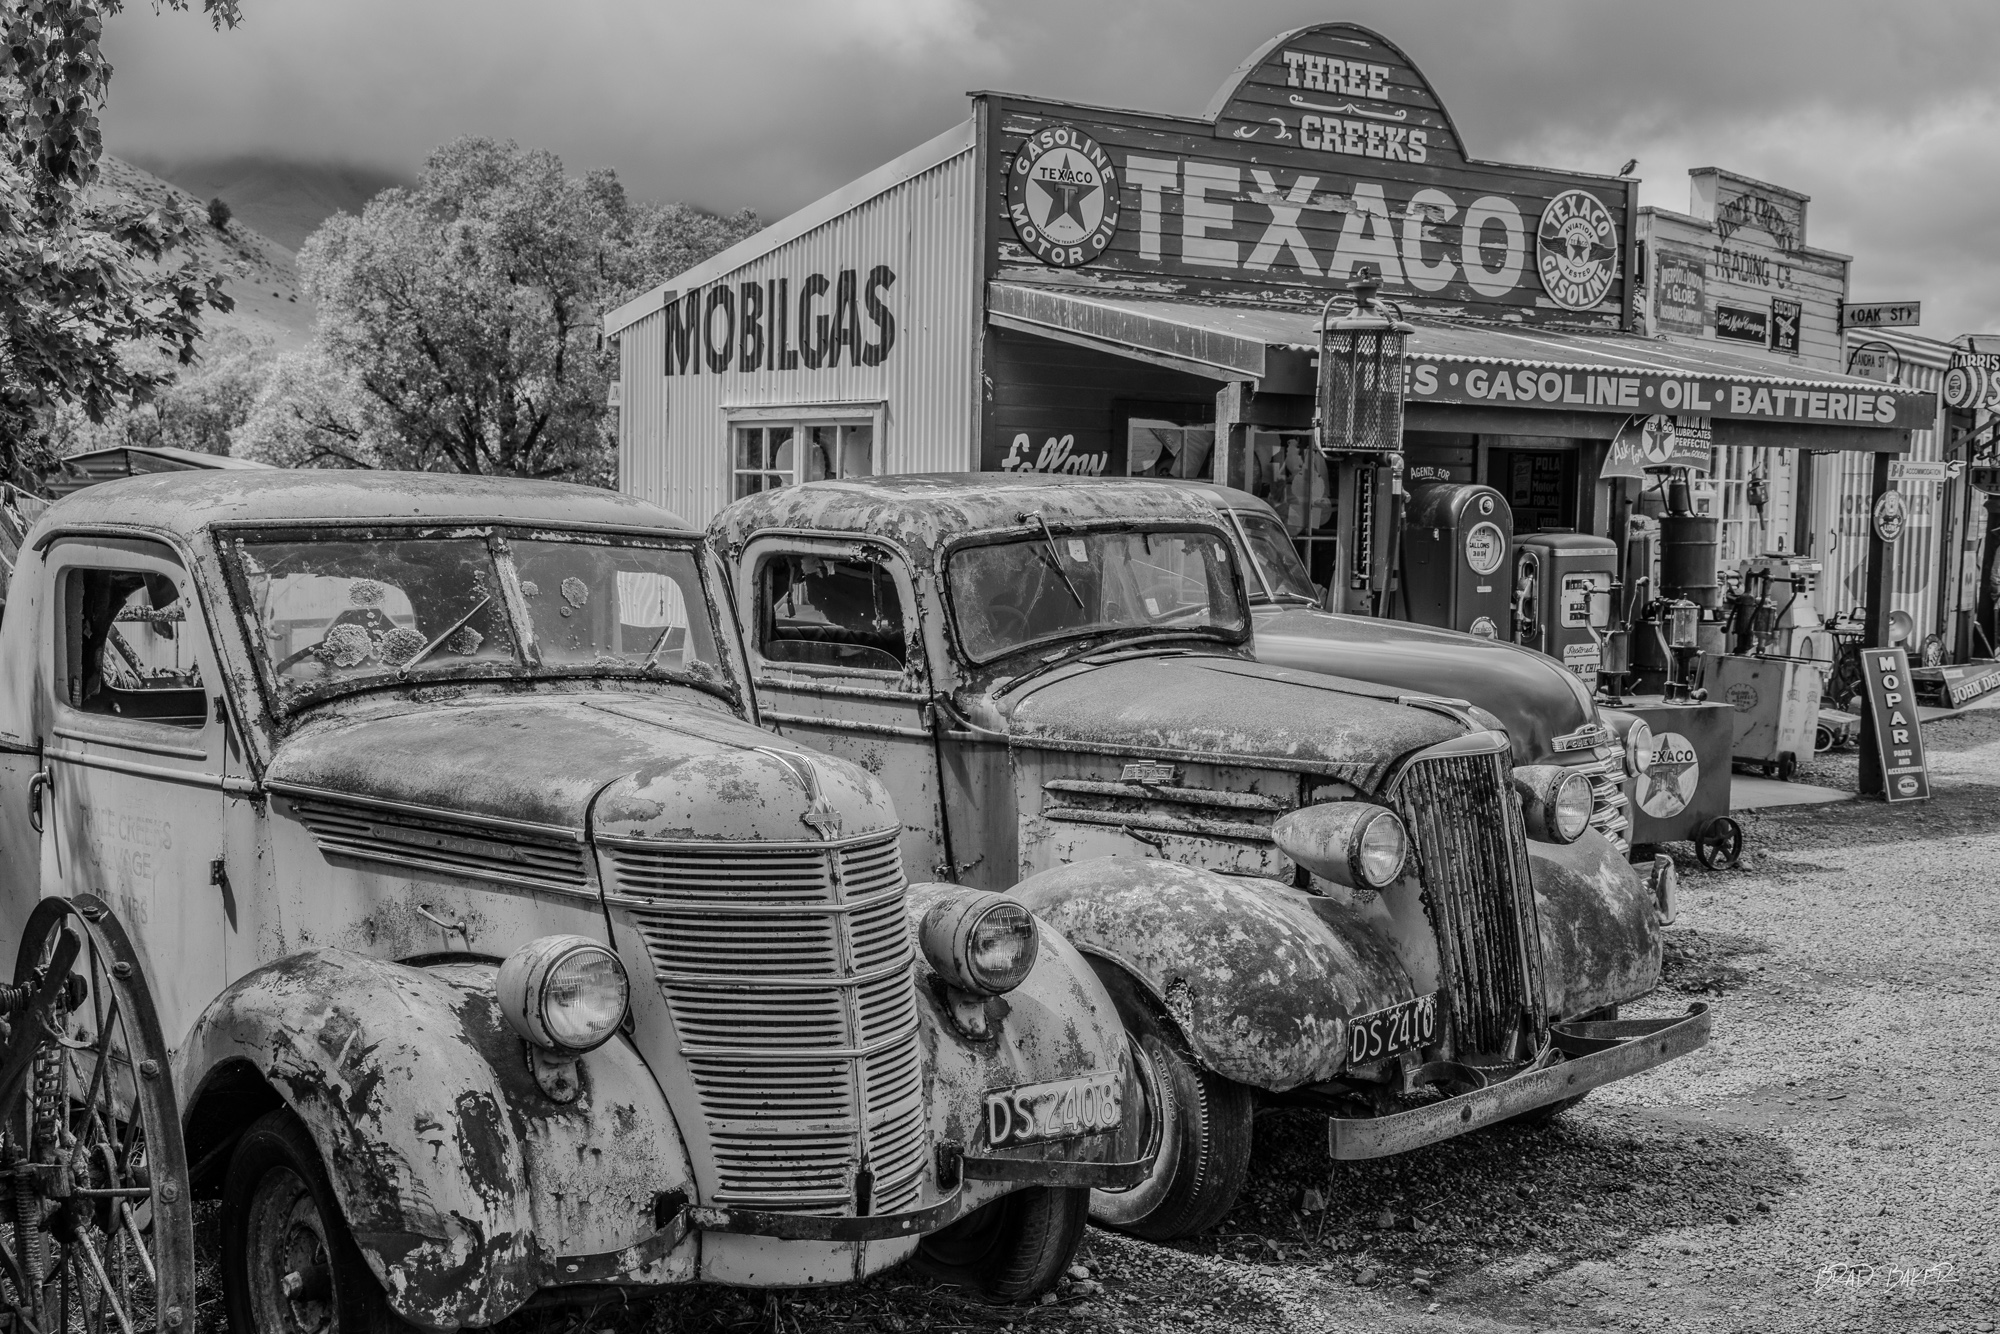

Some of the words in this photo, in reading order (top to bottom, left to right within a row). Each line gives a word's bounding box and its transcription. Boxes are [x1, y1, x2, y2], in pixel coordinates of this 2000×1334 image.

[1283, 50, 1390, 100] THREE
[1300, 115, 1428, 164] CREEKS
[1016, 129, 1115, 184] GASOLINE
[1040, 167, 1093, 184] TEXACO
[1126, 155, 1526, 297] TEXACO
[1545, 195, 1610, 237] TEXACO
[1010, 203, 1084, 264] MOTOR
[1092, 212, 1118, 249] OIL
[1565, 222, 1594, 239] AVIATION
[1564, 265, 1591, 278] TESTED
[1714, 245, 1770, 286] TRADING
[1542, 255, 1611, 305] GASOLINE
[1672, 284, 1696, 305] GLOBE
[664, 264, 896, 376] MOBILGAS
[1773, 301, 1800, 318] SOCONY
[1857, 308, 1882, 322] OAK
[1890, 307, 1905, 321] ST
[1950, 354, 2000, 371] HARRIS
[1465, 369, 1640, 407] GASOLINE
[1660, 378, 1712, 411] OIL
[1730, 385, 1896, 424] BATTERIES
[1944, 366, 2000, 408] OILS
[1647, 421, 1674, 433] TEXCO
[1675, 426, 1709, 438] LUBRICATES
[1676, 414, 1698, 428] MOTOR
[1699, 415, 1710, 429] OIL
[1614, 439, 1629, 466] Ask
[1674, 435, 1709, 447] PERFECTLY
[1001, 433, 1108, 477] fllow
[1410, 466, 1434, 480] AGENTS
[1437, 468, 1451, 481] FOR
[1906, 467, 1941, 476] ACCOMMODATION
[1878, 656, 1909, 744] MOPAR
[1952, 680, 1982, 704] JOHN
[1650, 749, 1694, 763] EXACO
[1893, 749, 1913, 757] PARTS
[1887, 765, 1924, 775] ACCESSORIES
[1352, 1020, 1382, 1063] DS
[1387, 1002, 1435, 1052] 2410
[987, 1092, 1035, 1145] DS
[1043, 1081, 1117, 1136] 2408
